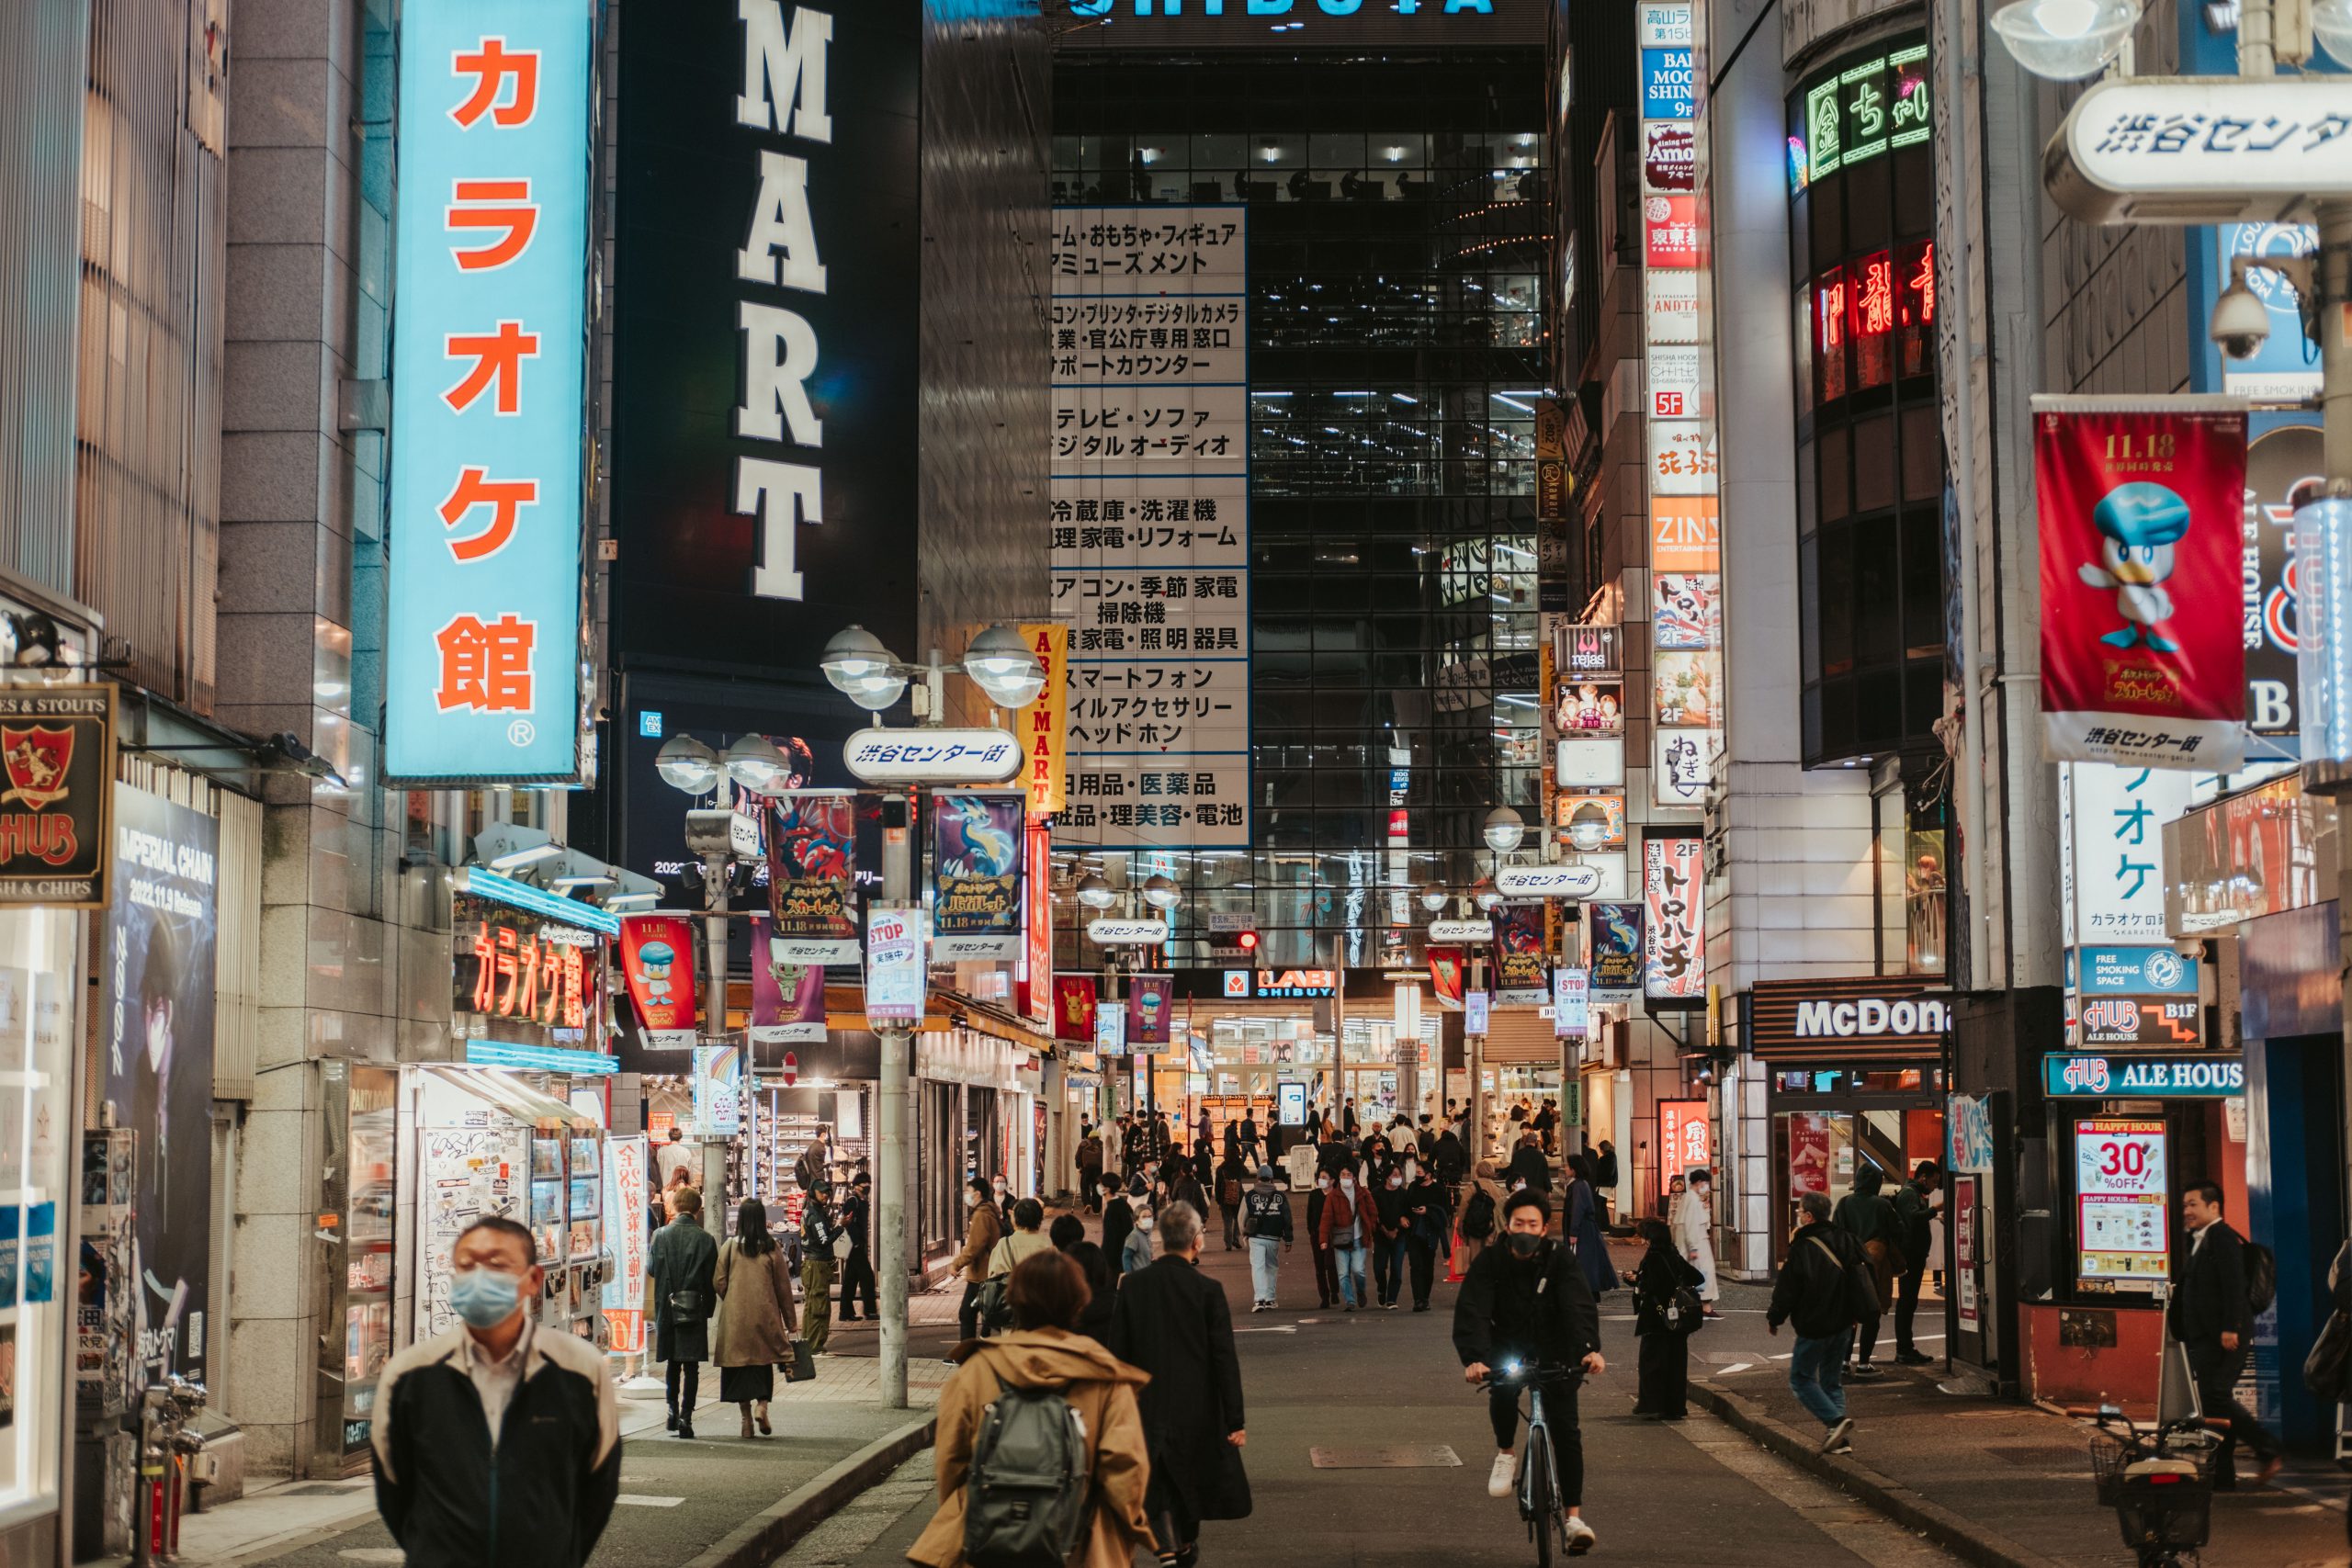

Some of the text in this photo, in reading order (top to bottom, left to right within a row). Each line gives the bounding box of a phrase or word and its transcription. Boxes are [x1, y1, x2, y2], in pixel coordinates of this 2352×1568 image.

[1647, 10, 1690, 25] 高山ラ
[1052, 328, 1230, 350] 業・官公庁専用窓口
[435, 35, 542, 715] カラオケ館
[1657, 394, 1681, 413] 5F
[1057, 408, 1210, 428] テレビ・ソファ
[1051, 434, 1230, 456] ジタルオーディオ
[2105, 434, 2176, 458] 11.18
[1050, 499, 1216, 522] 冷蔵庫・洗濯機
[1051, 576, 1238, 598] アコン・季節家電
[1098, 602, 1165, 625] 掃除機
[1659, 630, 1683, 645] 2F
[1572, 651, 1605, 668] rejas
[2114, 681, 2174, 701] スカーレット
[21, 699, 32, 712] &
[37, 698, 106, 713] STOUTS
[1069, 696, 1232, 718] イルアクセサリー
[1660, 707, 1684, 722] 2F
[1069, 723, 1182, 744] ヘッドホン
[2085, 727, 2203, 752] 渋谷センター街
[855, 745, 1010, 762] 渋谷センター街
[1610, 800, 1621, 808] 3F
[0, 814, 78, 866] HUB
[119, 826, 213, 885] IMPERIAL CHAIN
[1676, 844, 1699, 857] 2F
[1502, 874, 1594, 886] 渋谷センター街
[38, 882, 91, 896] CHIPS
[786, 898, 841, 915] スカーレット
[781, 920, 808, 931] 11.18
[941, 918, 968, 928] 11.18
[1660, 865, 1695, 979] トロハチ
[870, 923, 903, 943] STOP
[1093, 926, 1163, 936] 渋谷センター街
[948, 942, 1004, 952] 渋谷センター街
[1647, 925, 1657, 955] 渋谷店
[787, 946, 840, 955] 渋谷センター街
[876, 950, 904, 964] 実施中
[2096, 955, 2117, 964] FREE
[474, 921, 583, 1029] カラオケ館
[2096, 965, 2140, 975] SMOKING
[1562, 979, 1585, 990] STOP
[2096, 976, 2125, 986] SPACE
[2084, 1000, 2141, 1032] HUB
[2165, 1004, 2198, 1018] B1F
[770, 1027, 812, 1037] 渋谷センター街
[2064, 1059, 2244, 1093] HUB ALE HOUS
[2095, 1122, 2131, 1132] HAPPY
[2132, 1122, 2162, 1132] HOUR
[2100, 1142, 2143, 1176] 30
